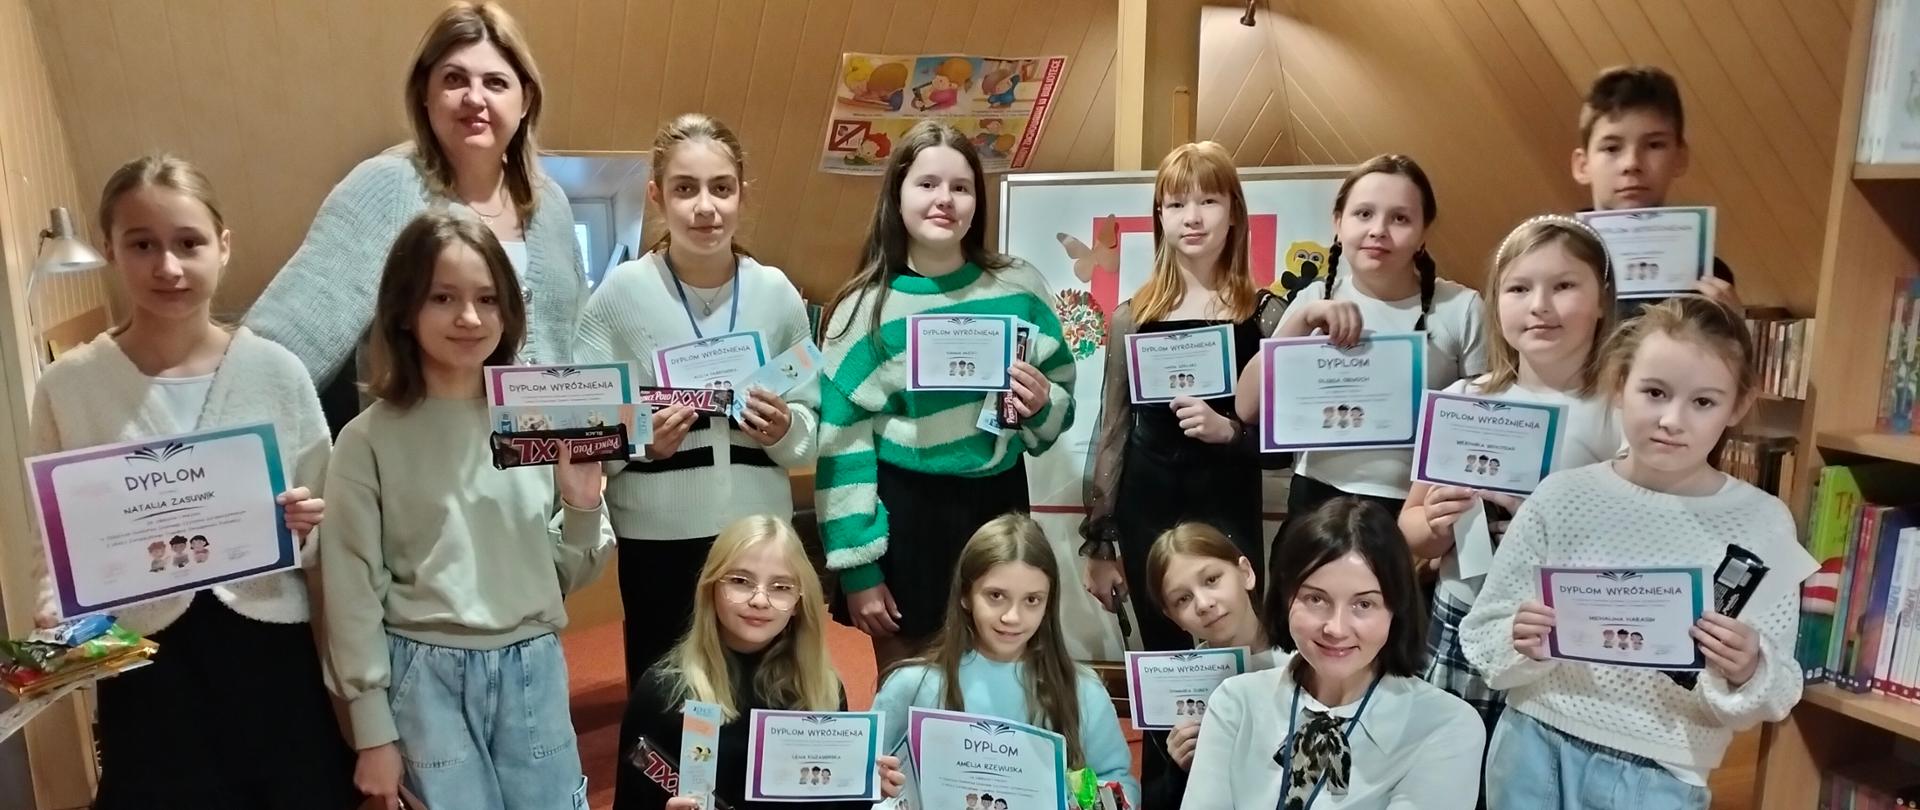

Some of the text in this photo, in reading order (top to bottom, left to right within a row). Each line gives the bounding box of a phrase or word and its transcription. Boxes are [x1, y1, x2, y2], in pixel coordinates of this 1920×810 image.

[671, 354, 700, 365] DYPLOM
[1317, 358, 1370, 369] DYPLOM
[509, 384, 547, 393] DYPLOM
[671, 390, 718, 412] XXL
[1440, 410, 1474, 421] DYPLOM
[573, 442, 592, 456] POLO
[594, 437, 620, 451] PRINCE
[124, 466, 206, 491] DYPLOM
[123, 490, 216, 515] NATALIA ZASUWIK
[1559, 585, 1602, 595] DYPLOM
[1144, 666, 1175, 674] DYPLOM
[771, 727, 804, 736] DYPLOM
[964, 738, 1018, 757] DYPLOM
[956, 760, 1023, 774] AMELIA RZEWUSKA
